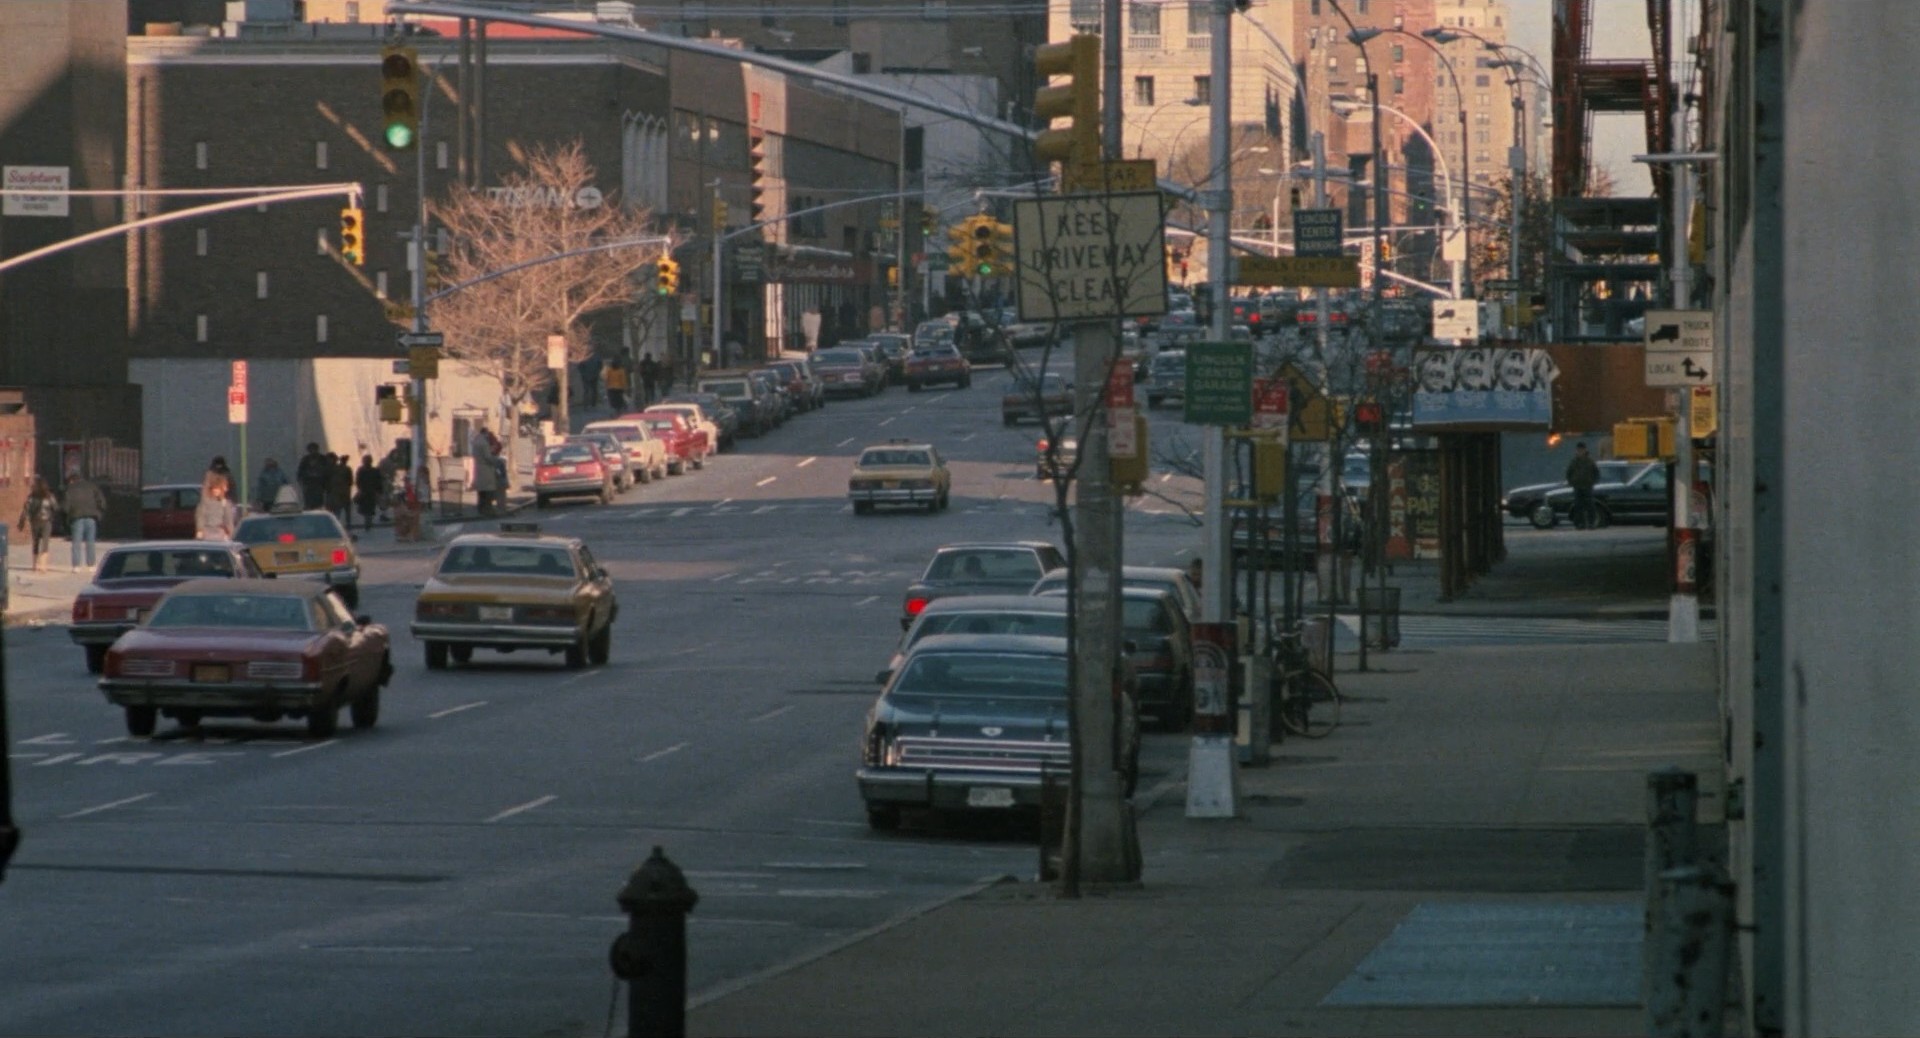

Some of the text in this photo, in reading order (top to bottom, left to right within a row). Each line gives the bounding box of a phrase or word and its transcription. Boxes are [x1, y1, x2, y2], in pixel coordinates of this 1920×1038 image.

[1299, 213, 1336, 224] LINCOLN
[1301, 226, 1336, 238] CENTER
[1032, 242, 1152, 270] DRIVEWAY
[1056, 277, 1129, 302] CLEAR
[1683, 320, 1710, 330] TRUCK
[1682, 337, 1711, 347] ROUTE
[1648, 363, 1677, 374] LOCAL
[1389, 478, 1405, 537] PARK
